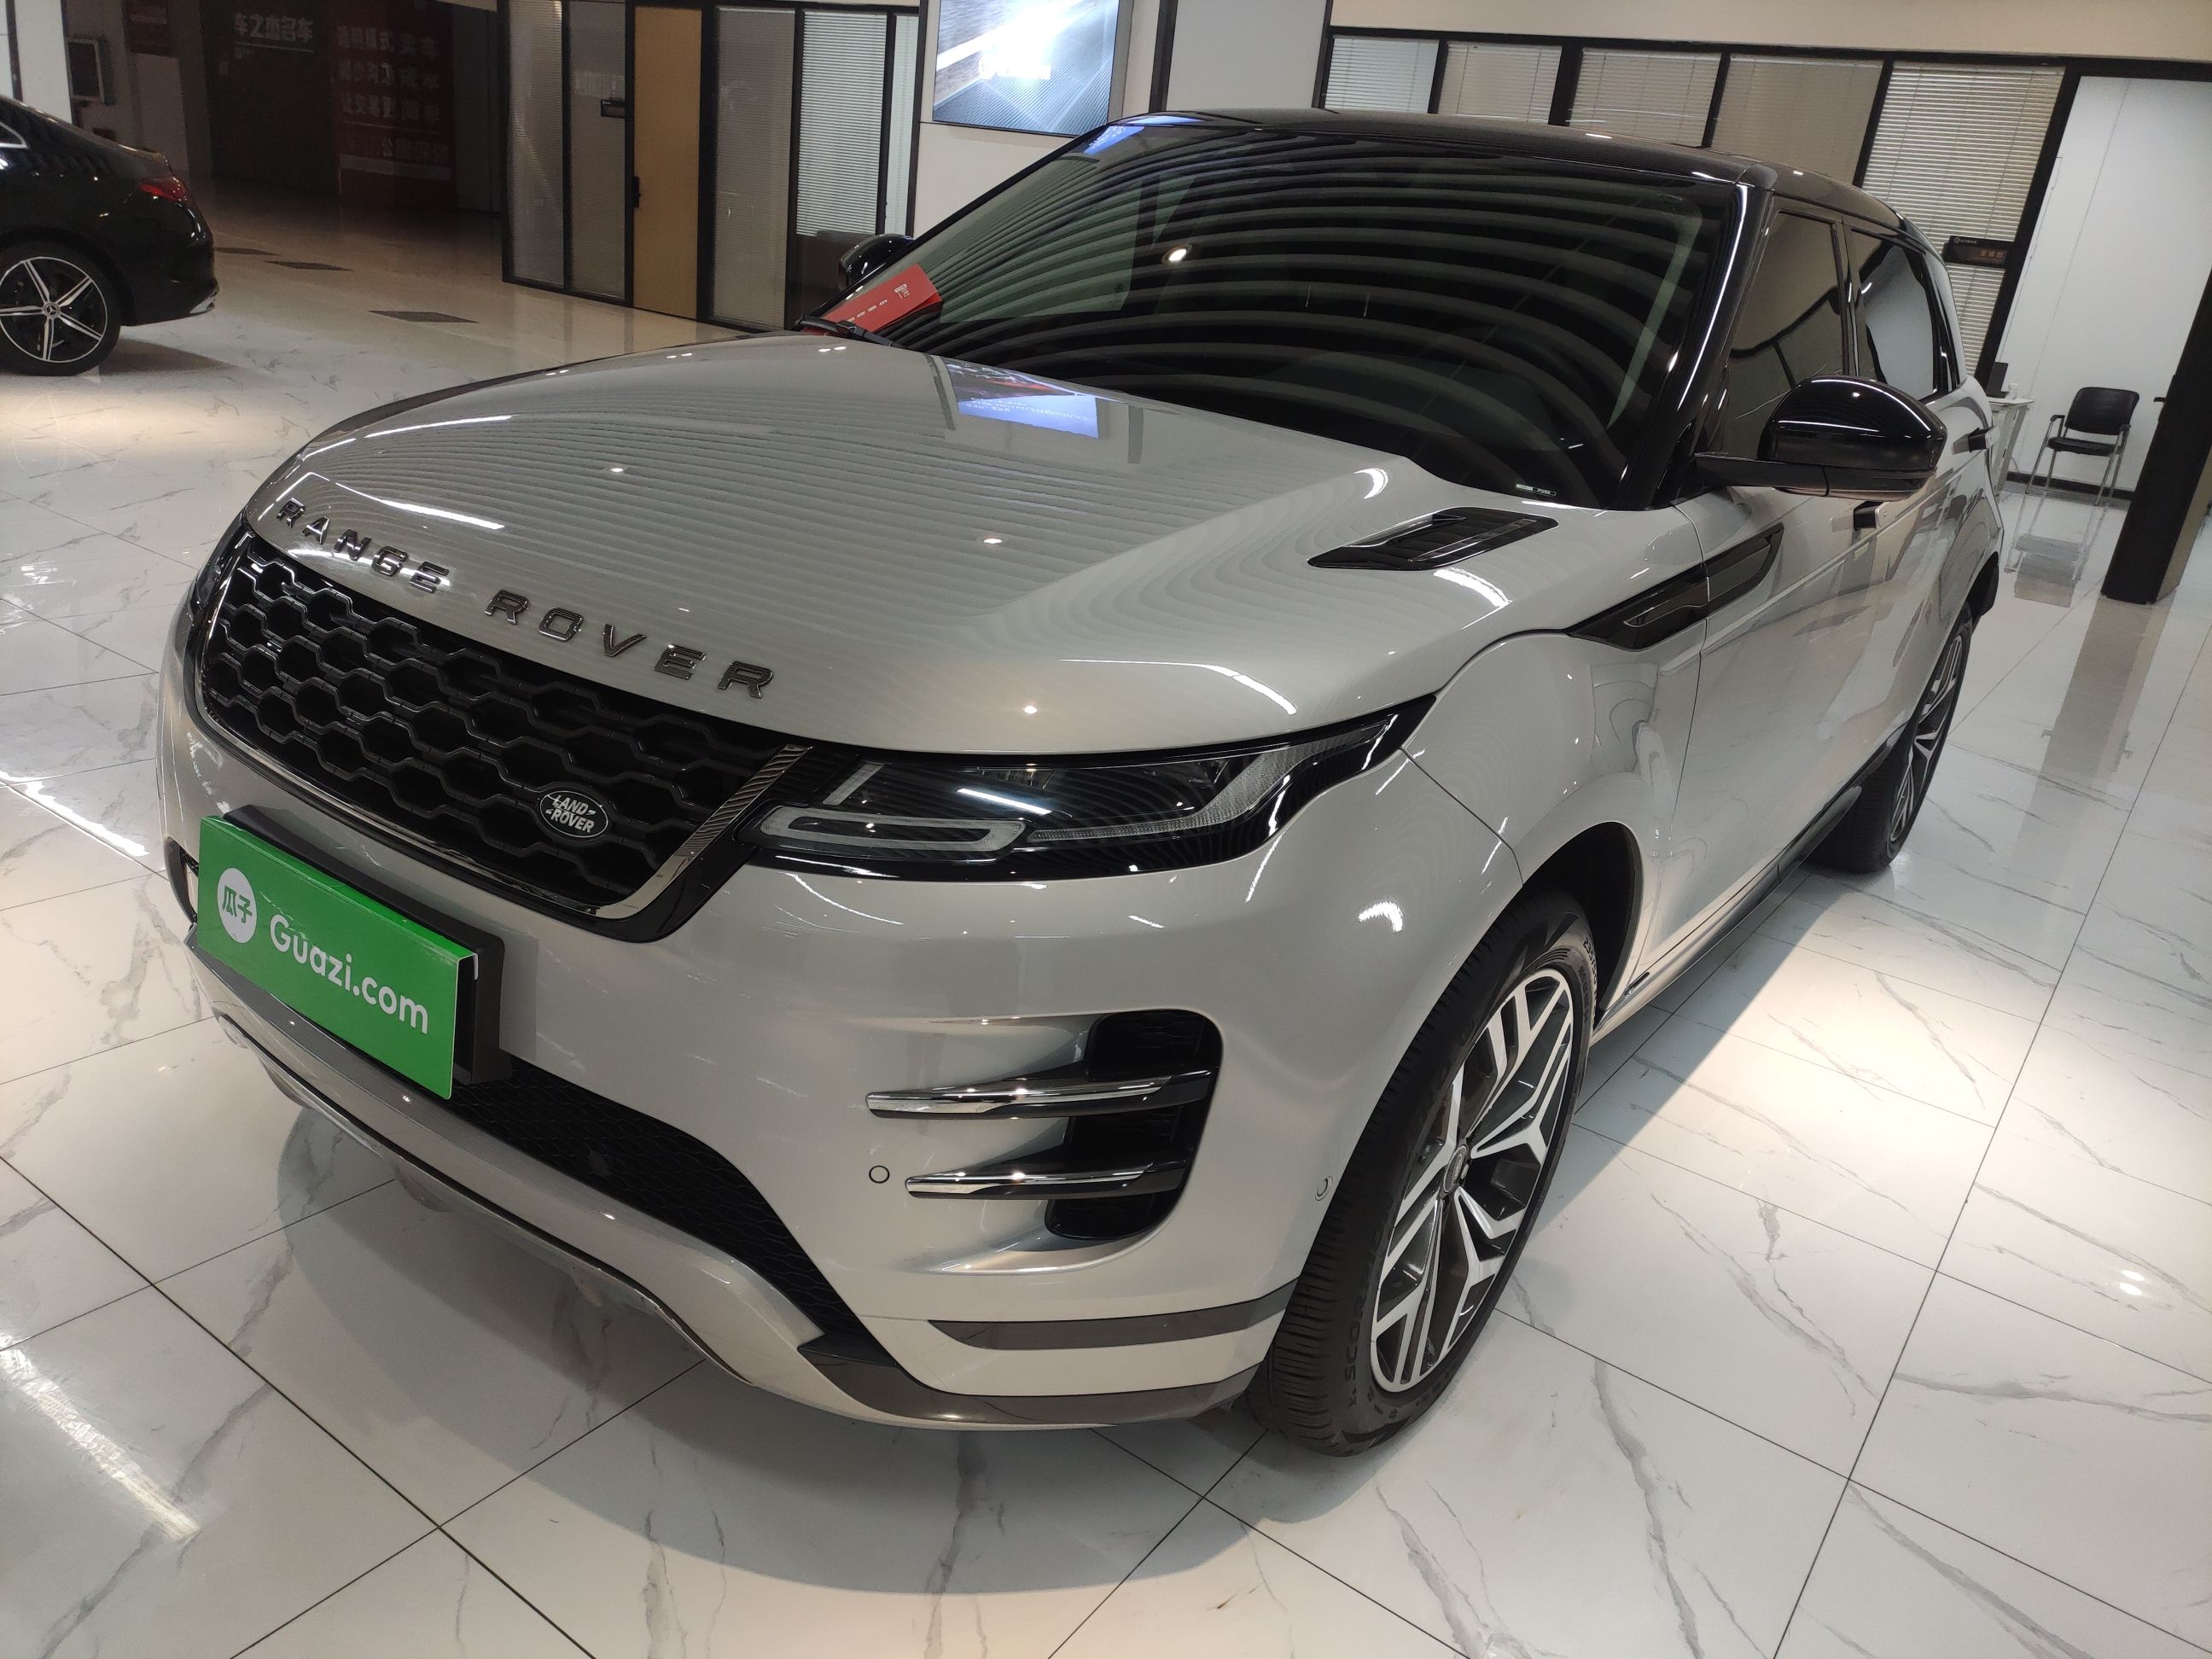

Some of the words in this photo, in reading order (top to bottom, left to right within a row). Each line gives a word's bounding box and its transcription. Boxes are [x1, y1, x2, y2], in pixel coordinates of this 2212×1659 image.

[276, 497, 451, 594] RANGE
[485, 588, 774, 699] ROVER
[550, 808, 595, 833] ROVER
[552, 795, 589, 816] LAND
[222, 886, 253, 923] 瓜子
[270, 914, 429, 1034] Guazi.com
